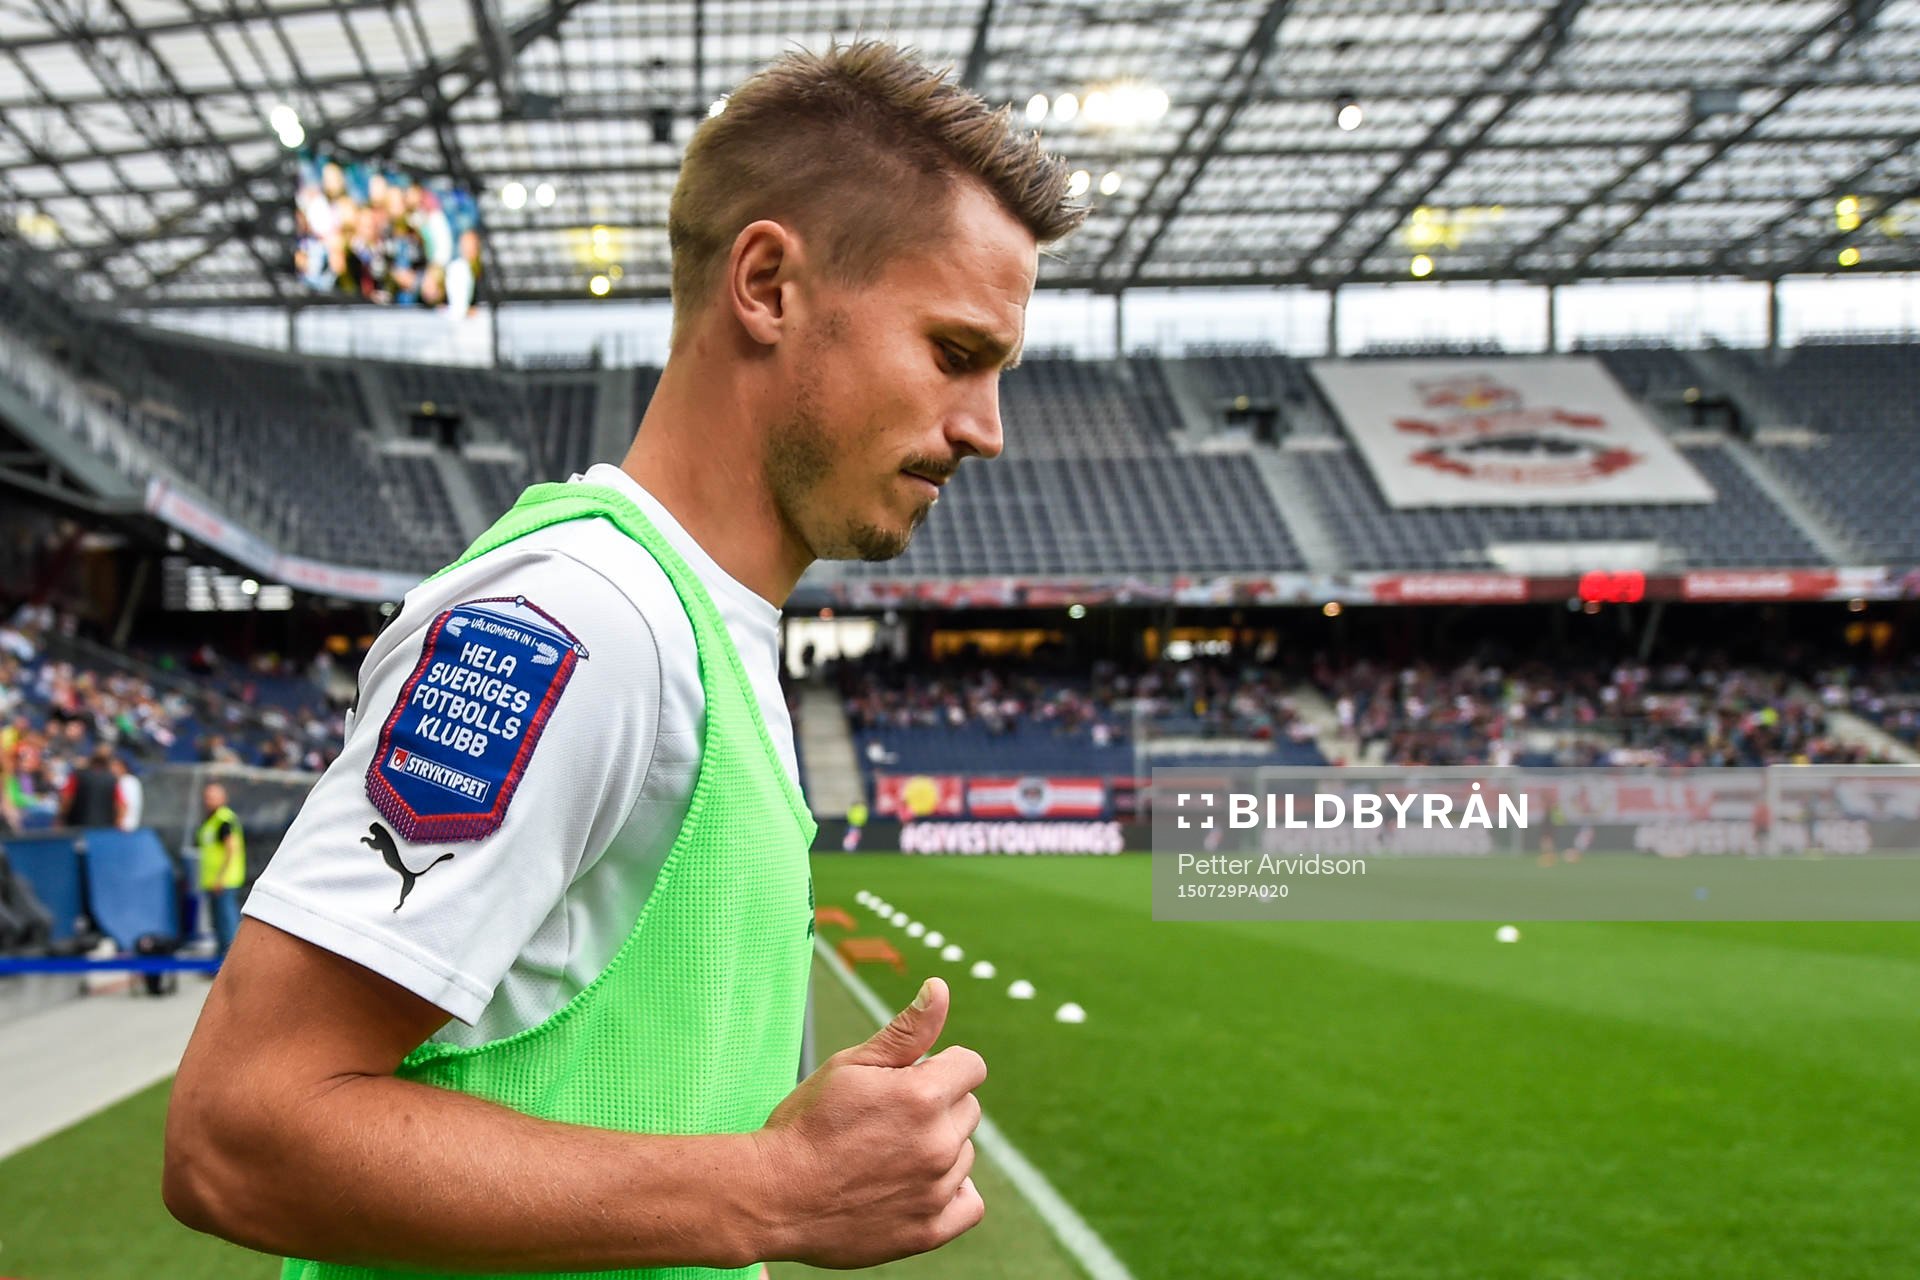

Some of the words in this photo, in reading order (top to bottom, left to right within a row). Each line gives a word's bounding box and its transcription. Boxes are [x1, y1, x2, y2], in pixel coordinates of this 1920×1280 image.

[470, 617, 521, 642] VÄLKOMMEN
[520, 633, 532, 646] IN
[459, 641, 517, 678] HELA
[427, 662, 531, 714] SVERIGES
[411, 683, 522, 741] FOTBOLLS
[415, 714, 488, 758] KLUBB
[406, 756, 487, 798] STRYKTIPSET
